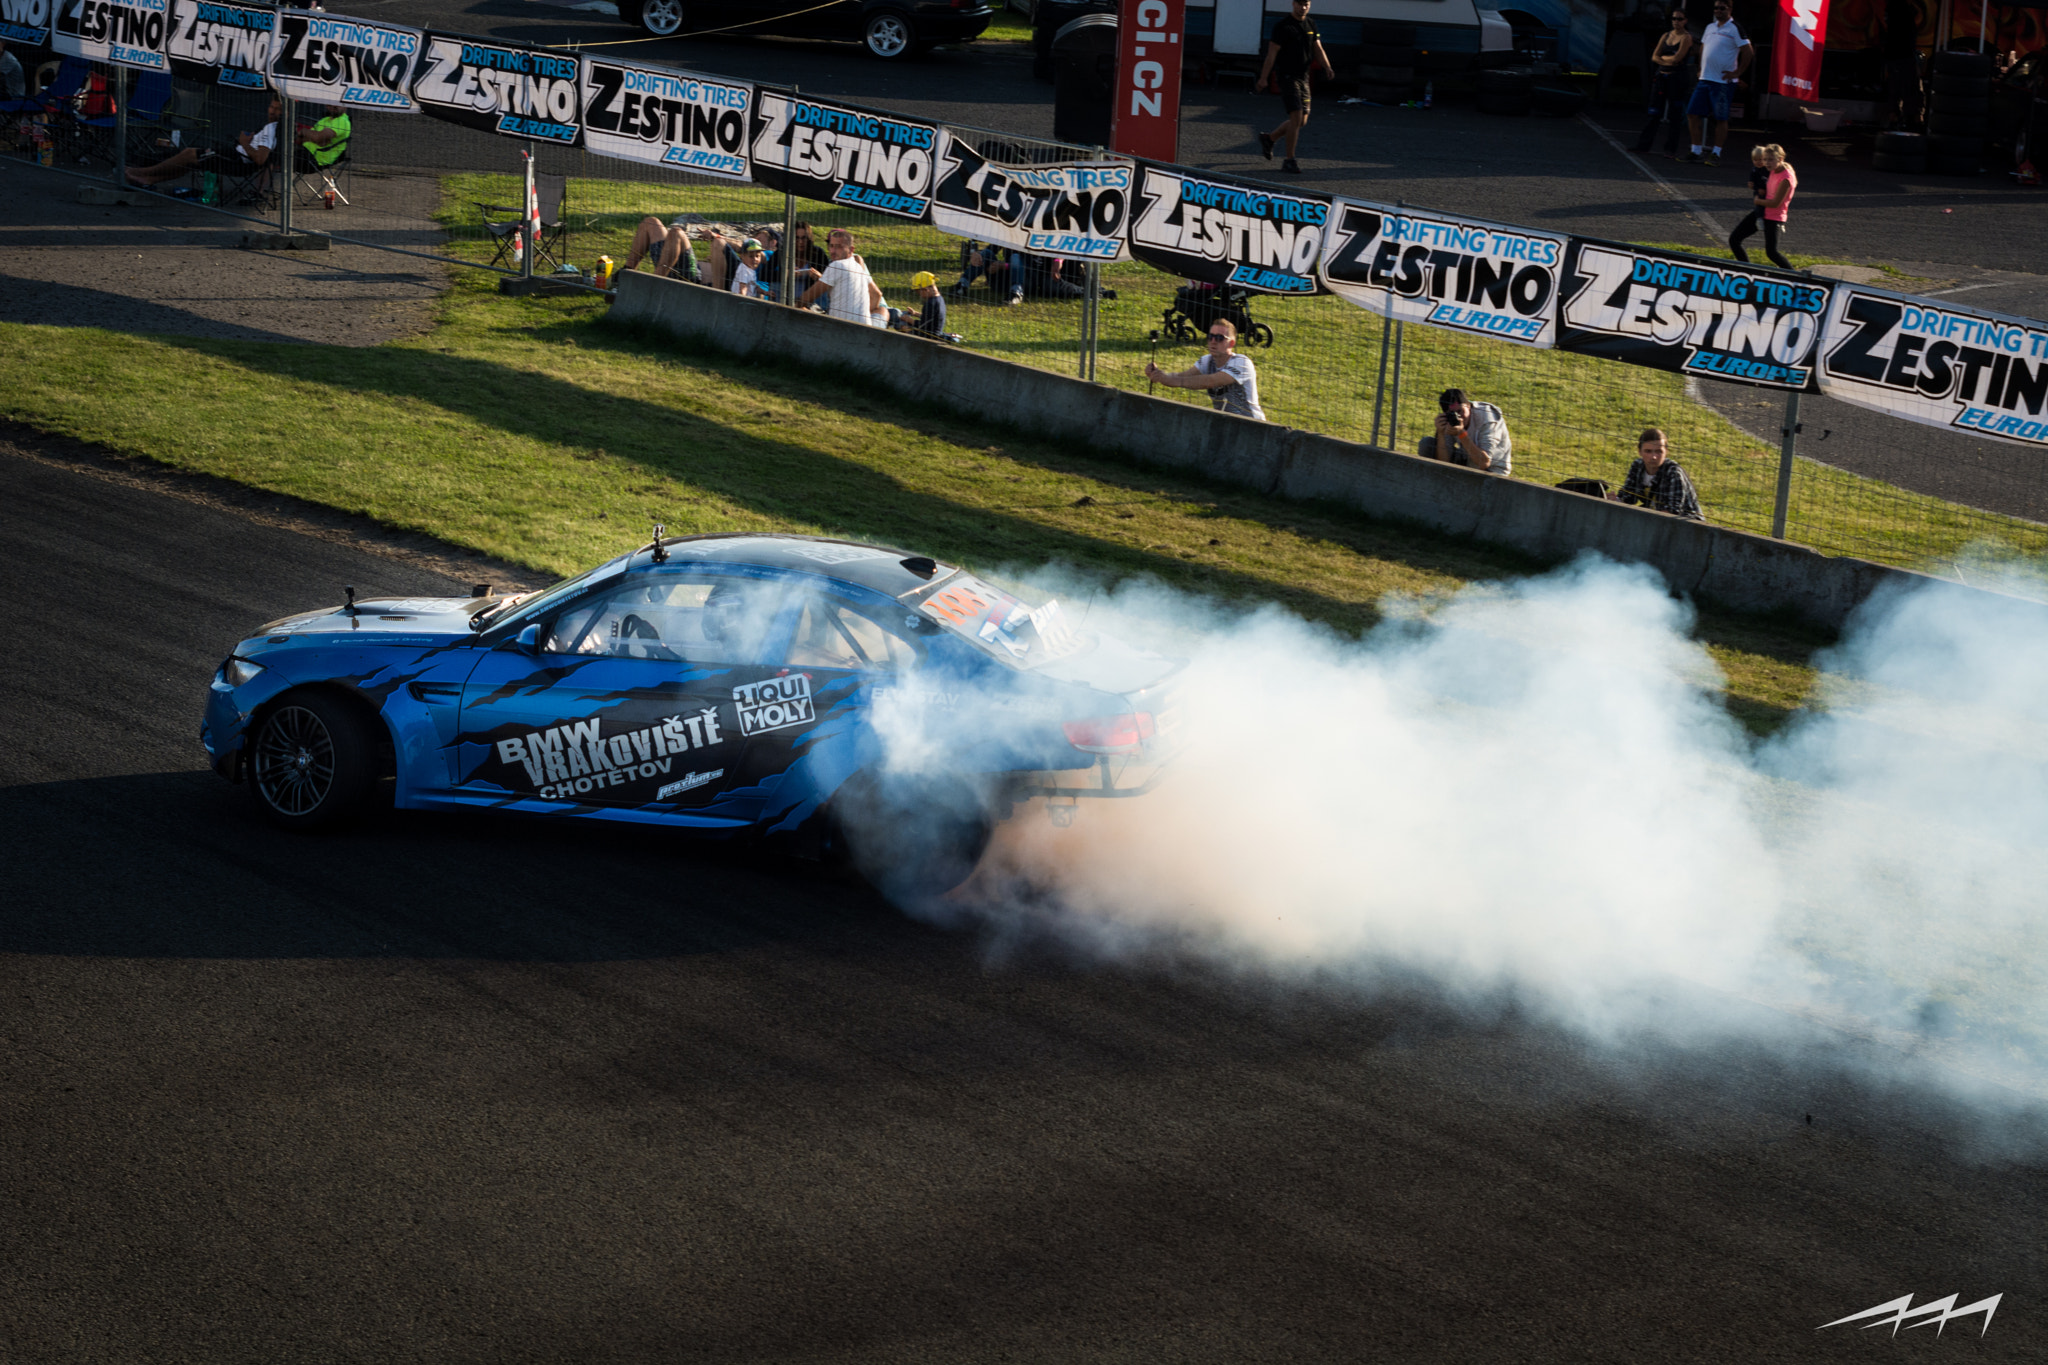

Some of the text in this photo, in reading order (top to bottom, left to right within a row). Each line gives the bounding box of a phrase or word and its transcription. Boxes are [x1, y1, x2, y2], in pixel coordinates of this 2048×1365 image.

[57, 0, 163, 50] ZESTINO
[169, 0, 270, 71] ZESTINO
[197, 3, 274, 31] DRIFTING TIRES
[308, 20, 416, 53] DRIFTING TIRES
[111, 46, 163, 67] EUROPE
[273, 17, 408, 92] ZESTINO
[462, 46, 575, 80] DRIFTING TIRES
[222, 68, 264, 87] EUROPE
[343, 87, 411, 106] EUROPE
[416, 41, 574, 122] ZESTINO
[624, 72, 747, 109] DRIFTING TIRES
[1782, 75, 1813, 91] MOTUL
[499, 116, 578, 141] EUROPE
[586, 65, 743, 153] ZESTINO
[795, 104, 933, 149] DRIFTING TIRES
[664, 147, 745, 172] EUROPE
[754, 95, 930, 195] ZESTINO
[836, 183, 927, 215] EUROPE
[936, 138, 1125, 236] ZESTINO
[1065, 169, 1128, 190] TIRES
[1135, 172, 1321, 274] ZESTINO
[1181, 180, 1327, 225] DRIFTING TIRES
[1028, 233, 1120, 256] EUROPE
[1382, 216, 1557, 265] DRIFTING TIRES
[1230, 265, 1314, 291] EUROPE
[1327, 208, 1552, 316] ZESTINO
[1632, 259, 1824, 312] DRIFTING TIRES
[1432, 304, 1543, 339] EUROPE
[1566, 249, 1816, 365] ZESTINO
[1901, 308, 2024, 353] DRIFTING
[1688, 351, 1809, 384] EUROPE
[1829, 296, 2048, 416] ZESTIN
[739, 677, 805, 708] LIQUI
[743, 698, 809, 732] MOLY
[497, 717, 600, 764] BMW
[522, 706, 723, 787] VRAKOVIŠTĚ
